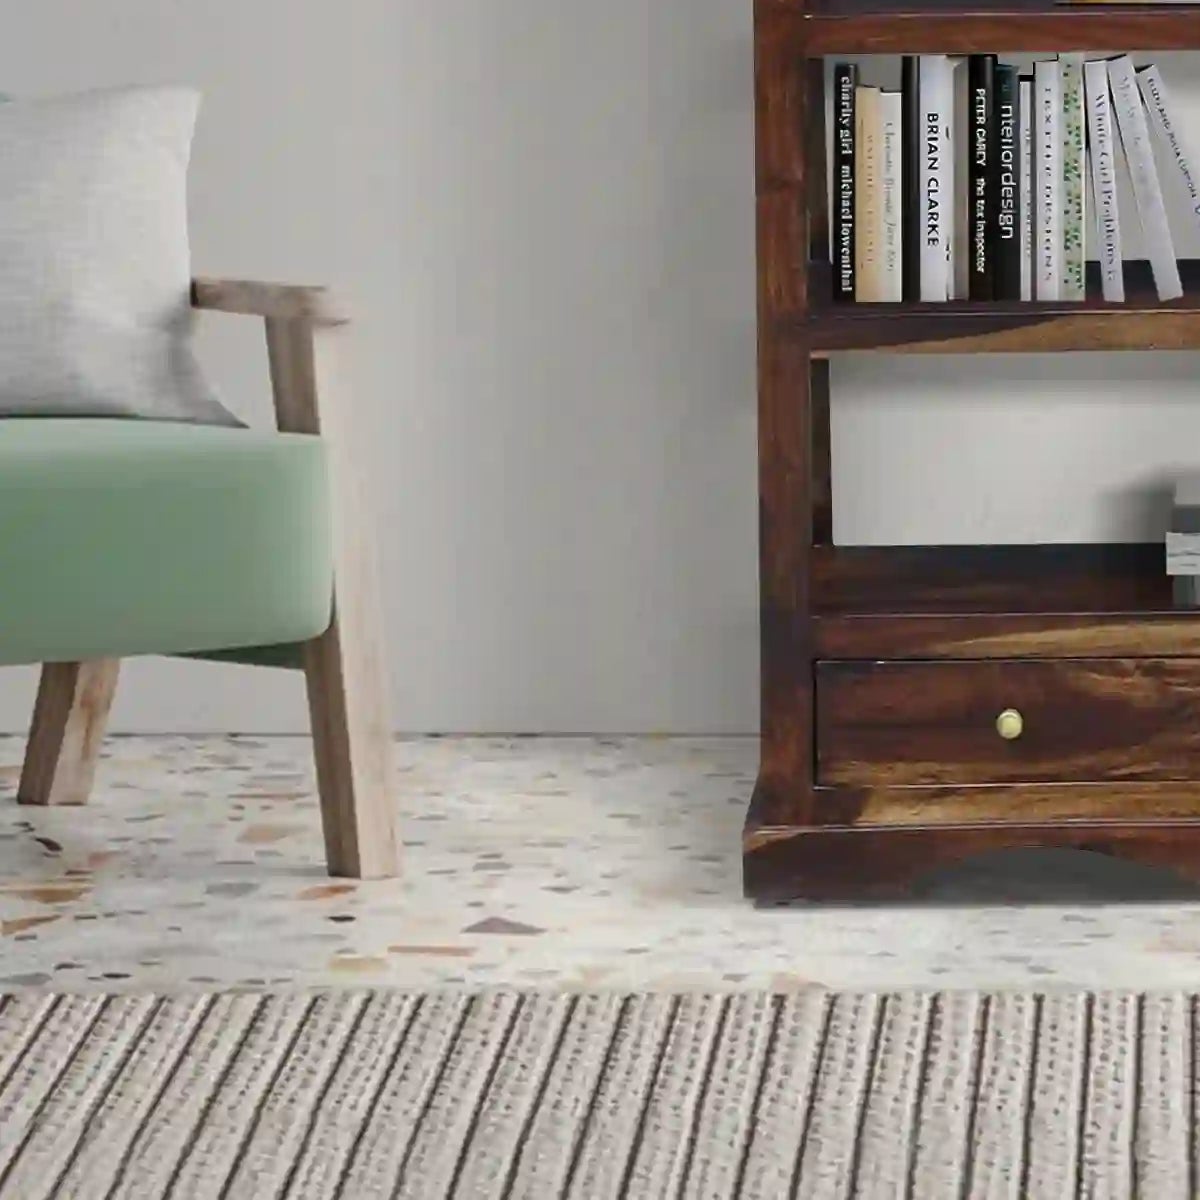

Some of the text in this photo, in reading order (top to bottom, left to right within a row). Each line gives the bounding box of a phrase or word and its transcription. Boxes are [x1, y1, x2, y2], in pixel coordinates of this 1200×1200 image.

[975, 88, 987, 125] PETER
[927, 112, 941, 247] BRIAN CLARKE
